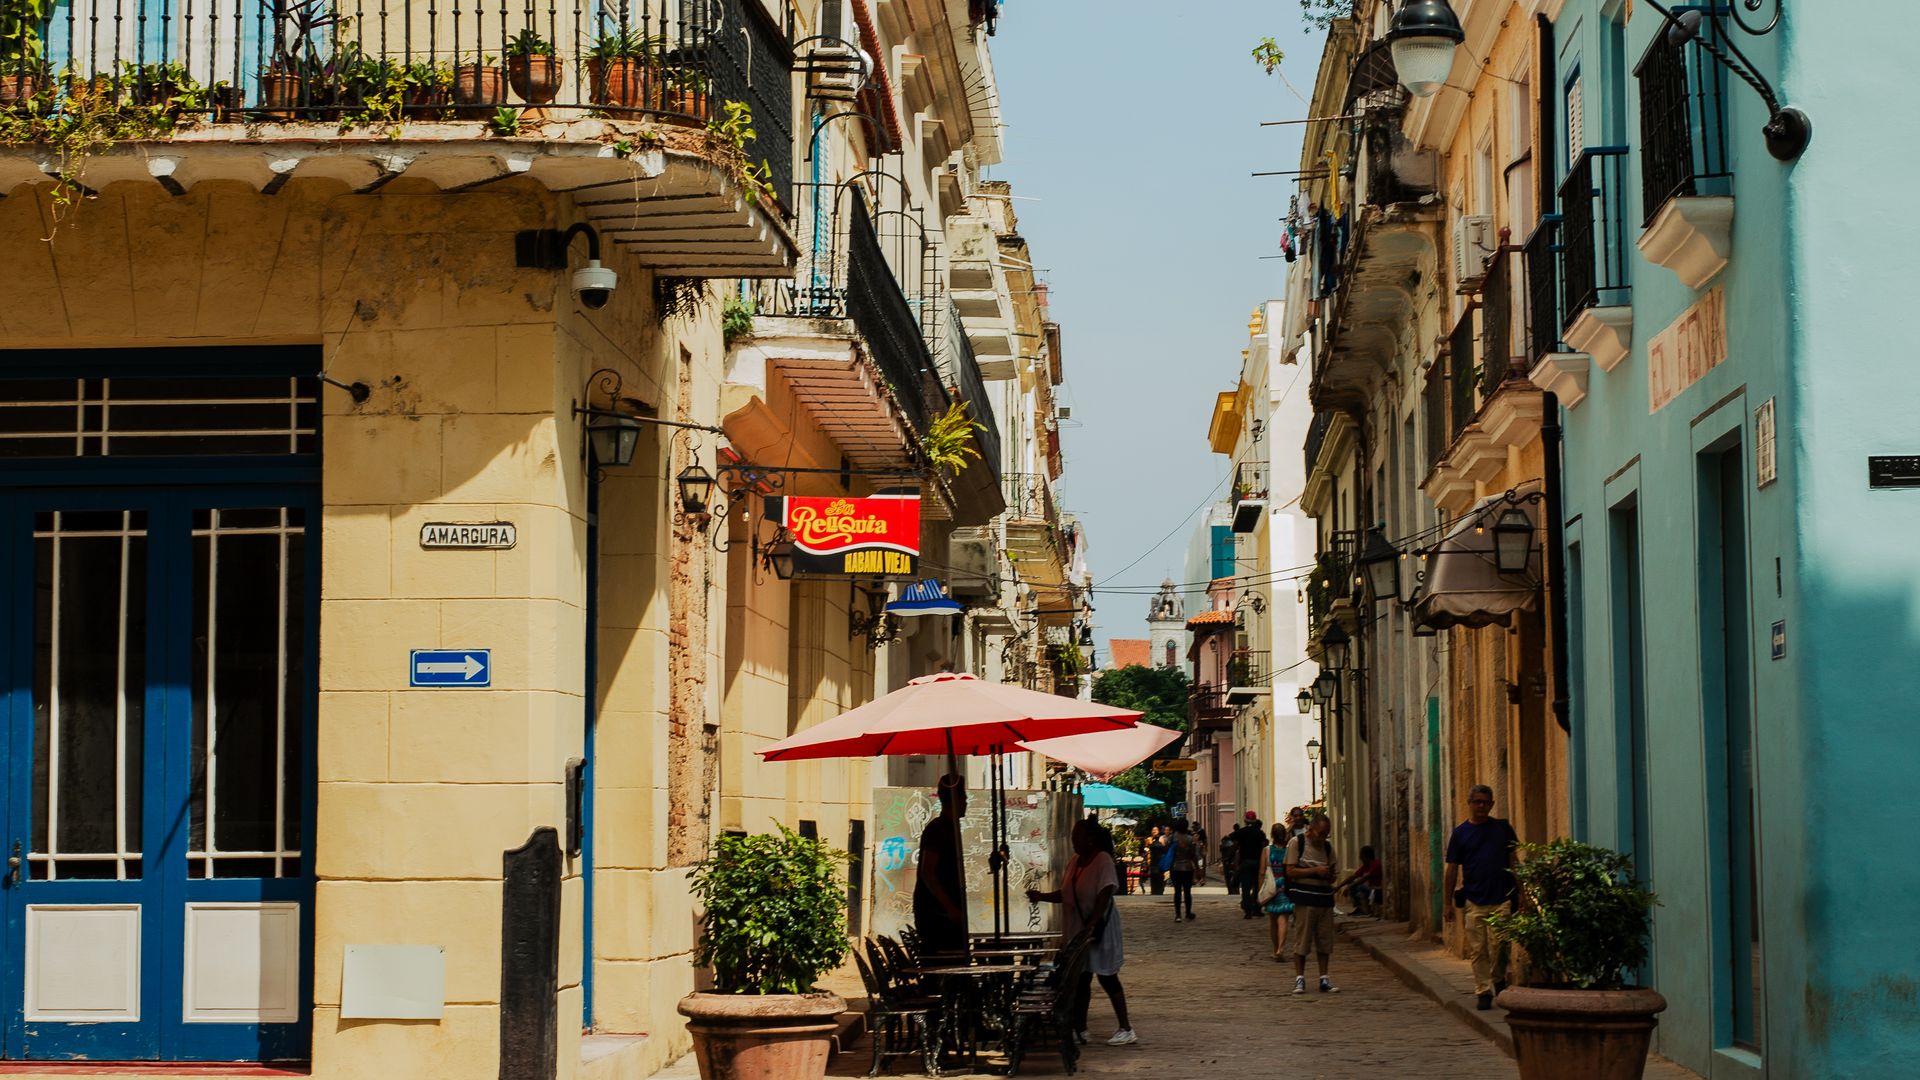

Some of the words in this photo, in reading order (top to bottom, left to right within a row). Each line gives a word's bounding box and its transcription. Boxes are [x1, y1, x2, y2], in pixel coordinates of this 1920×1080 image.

[825, 499, 856, 516] La
[427, 527, 509, 544] AMARGURA
[844, 550, 884, 573] HABANA
[884, 551, 911, 574] VIEJA
